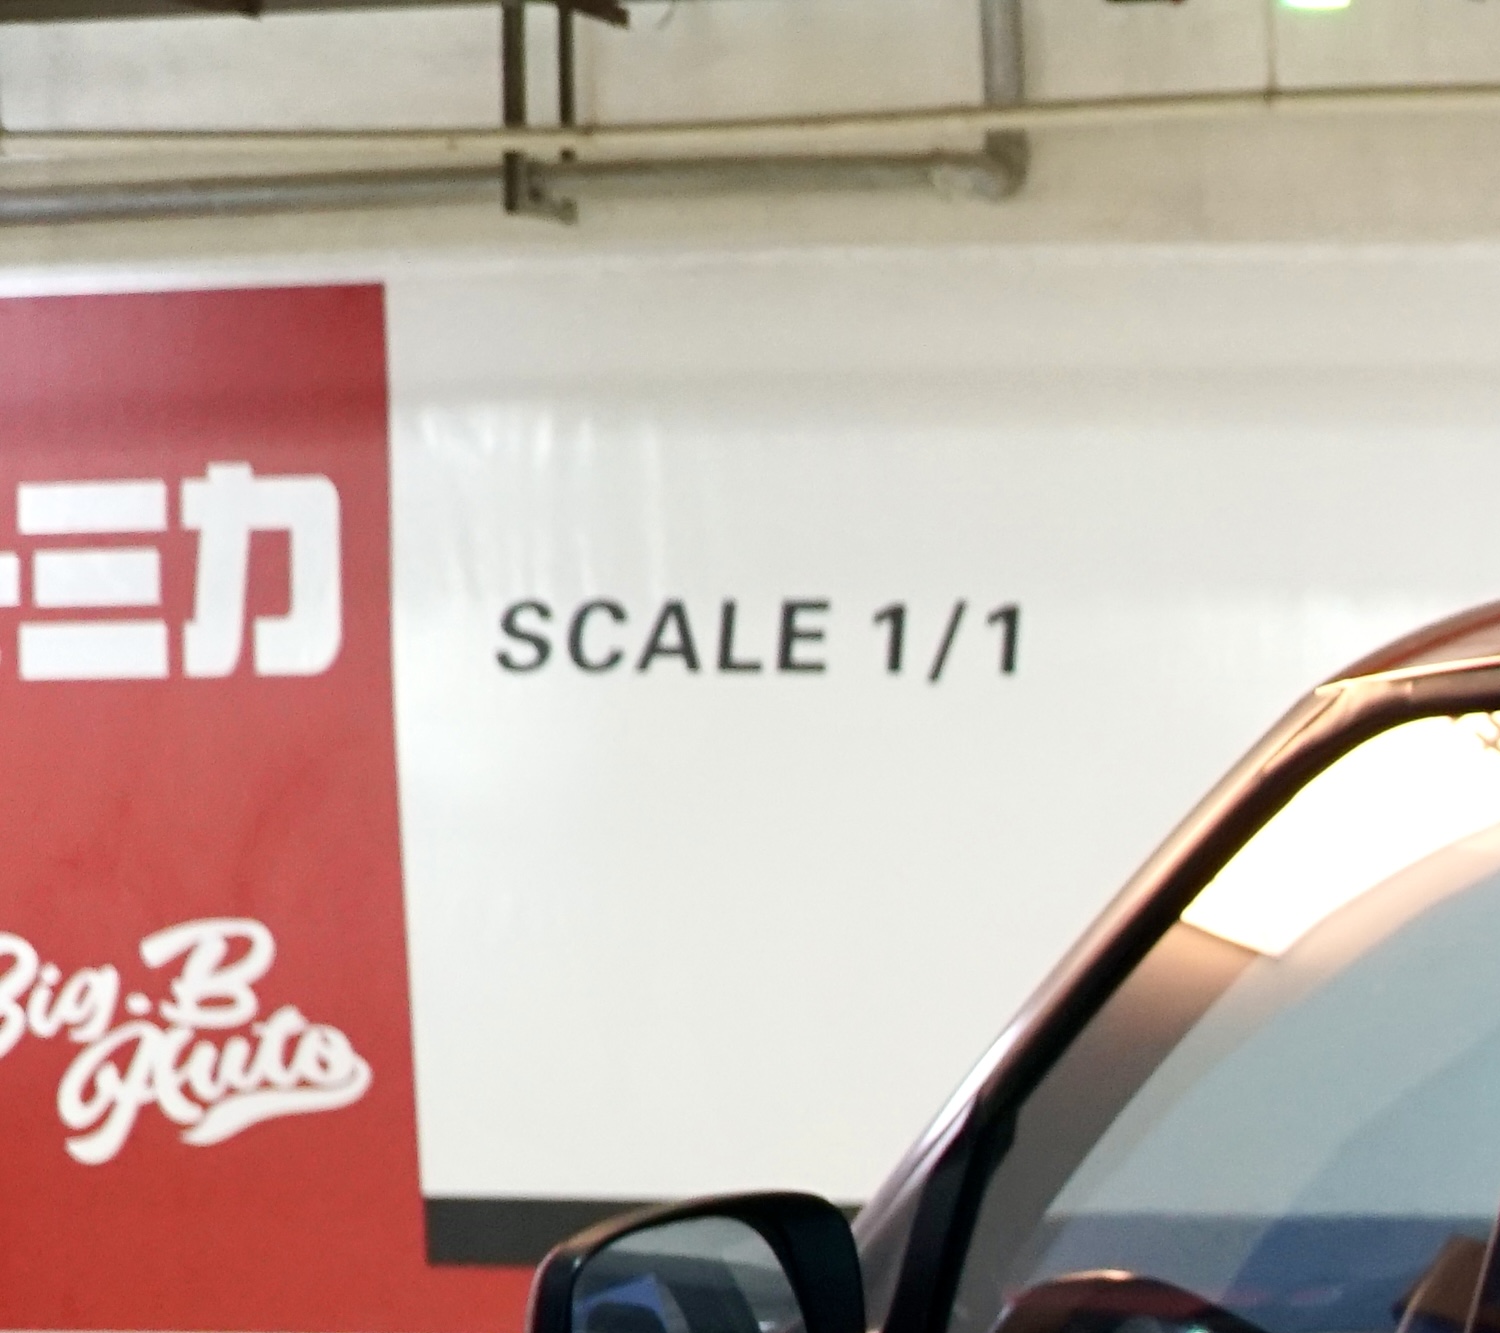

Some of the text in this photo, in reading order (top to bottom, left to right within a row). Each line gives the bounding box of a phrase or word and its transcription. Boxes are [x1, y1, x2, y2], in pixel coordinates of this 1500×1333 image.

[0, 460, 342, 681] ミカ
[496, 597, 1021, 686] SCALE 1/1
[57, 1003, 373, 1165] Auto
